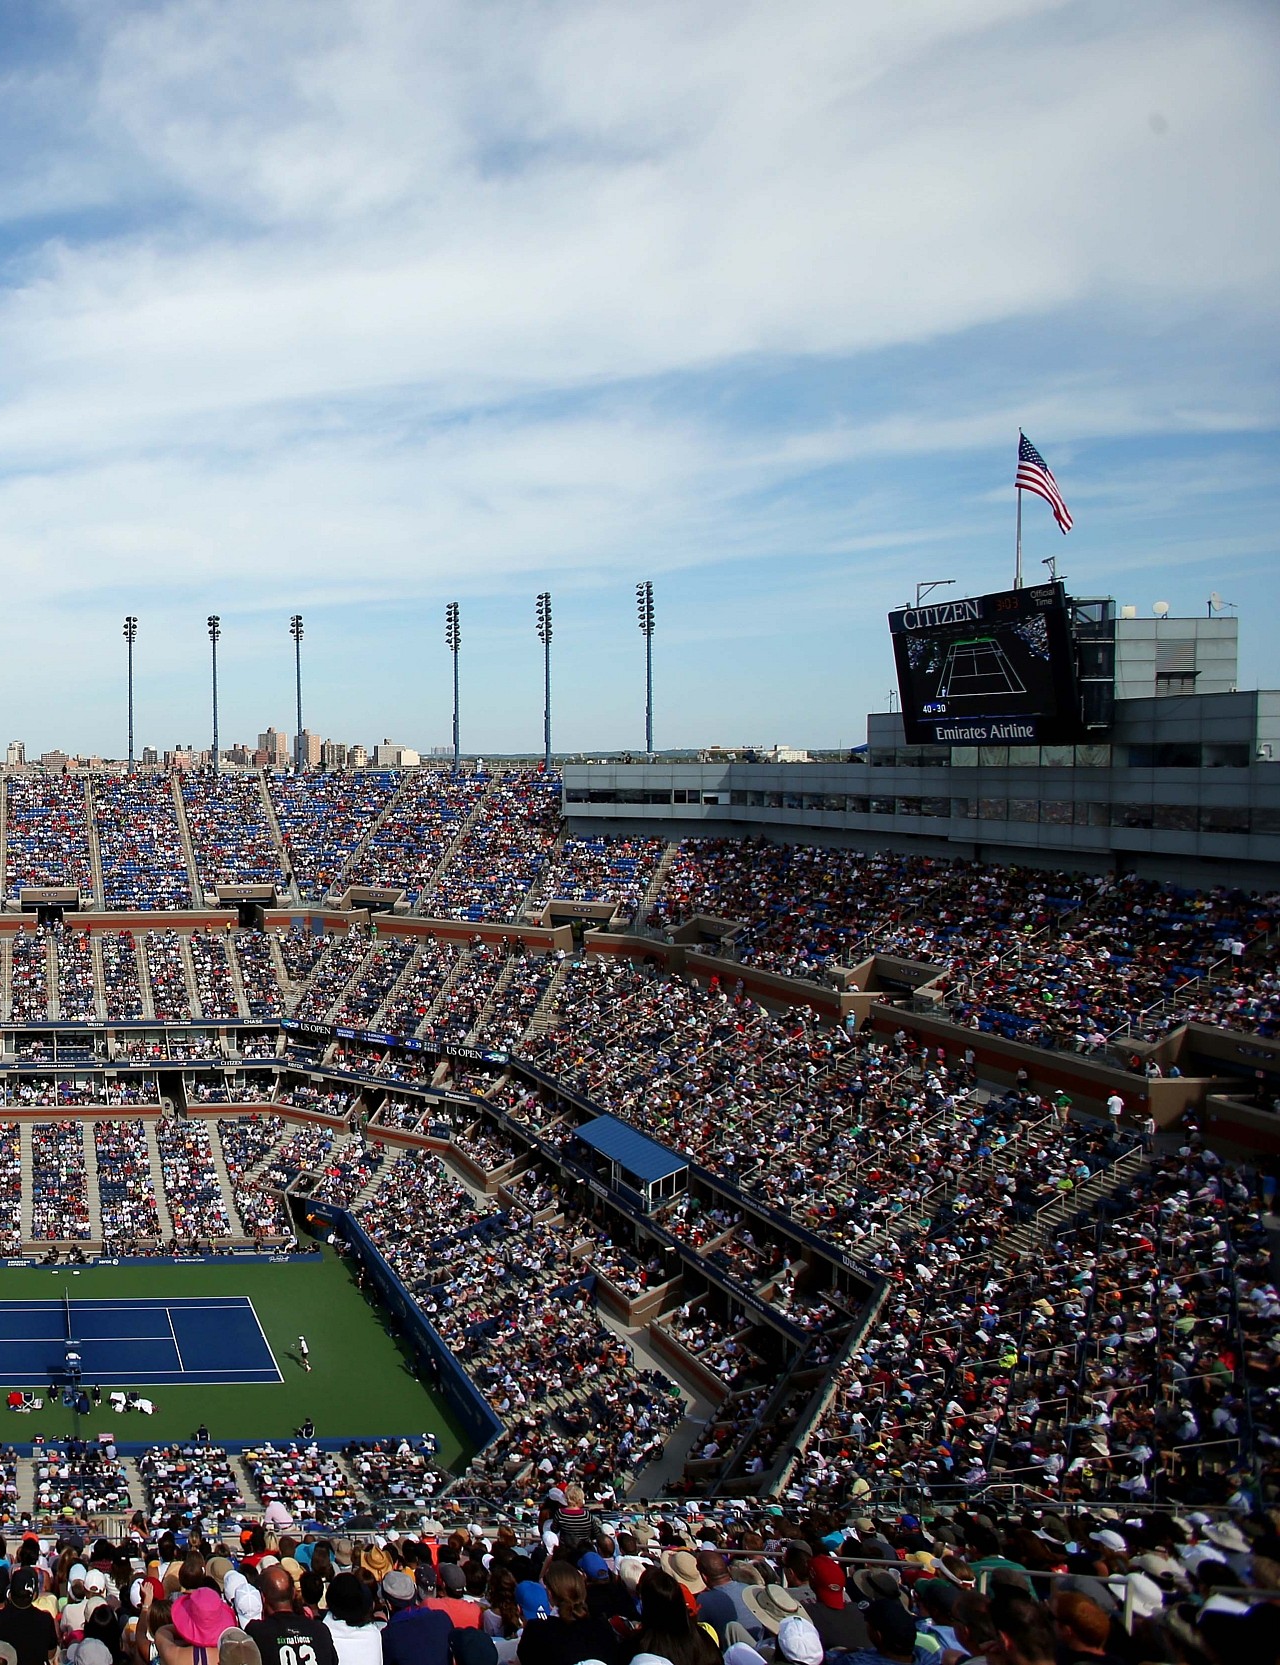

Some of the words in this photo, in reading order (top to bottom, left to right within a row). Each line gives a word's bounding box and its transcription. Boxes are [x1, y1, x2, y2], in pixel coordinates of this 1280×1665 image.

[1030, 588, 1055, 599] Official
[1035, 598, 1053, 607] Time
[903, 600, 980, 630] CITIZEN
[922, 705, 932, 713] 40
[937, 704, 946, 713] 30
[936, 726, 987, 740] Emirates
[990, 724, 1034, 739] Airline
[300, 1023, 310, 1031] US
[310, 1024, 331, 1035] OPEN
[446, 1046, 457, 1056] US
[458, 1048, 483, 1059] OPEN
[842, 1254, 867, 1278] Wilson
[277, 1635, 311, 1645] sixnations
